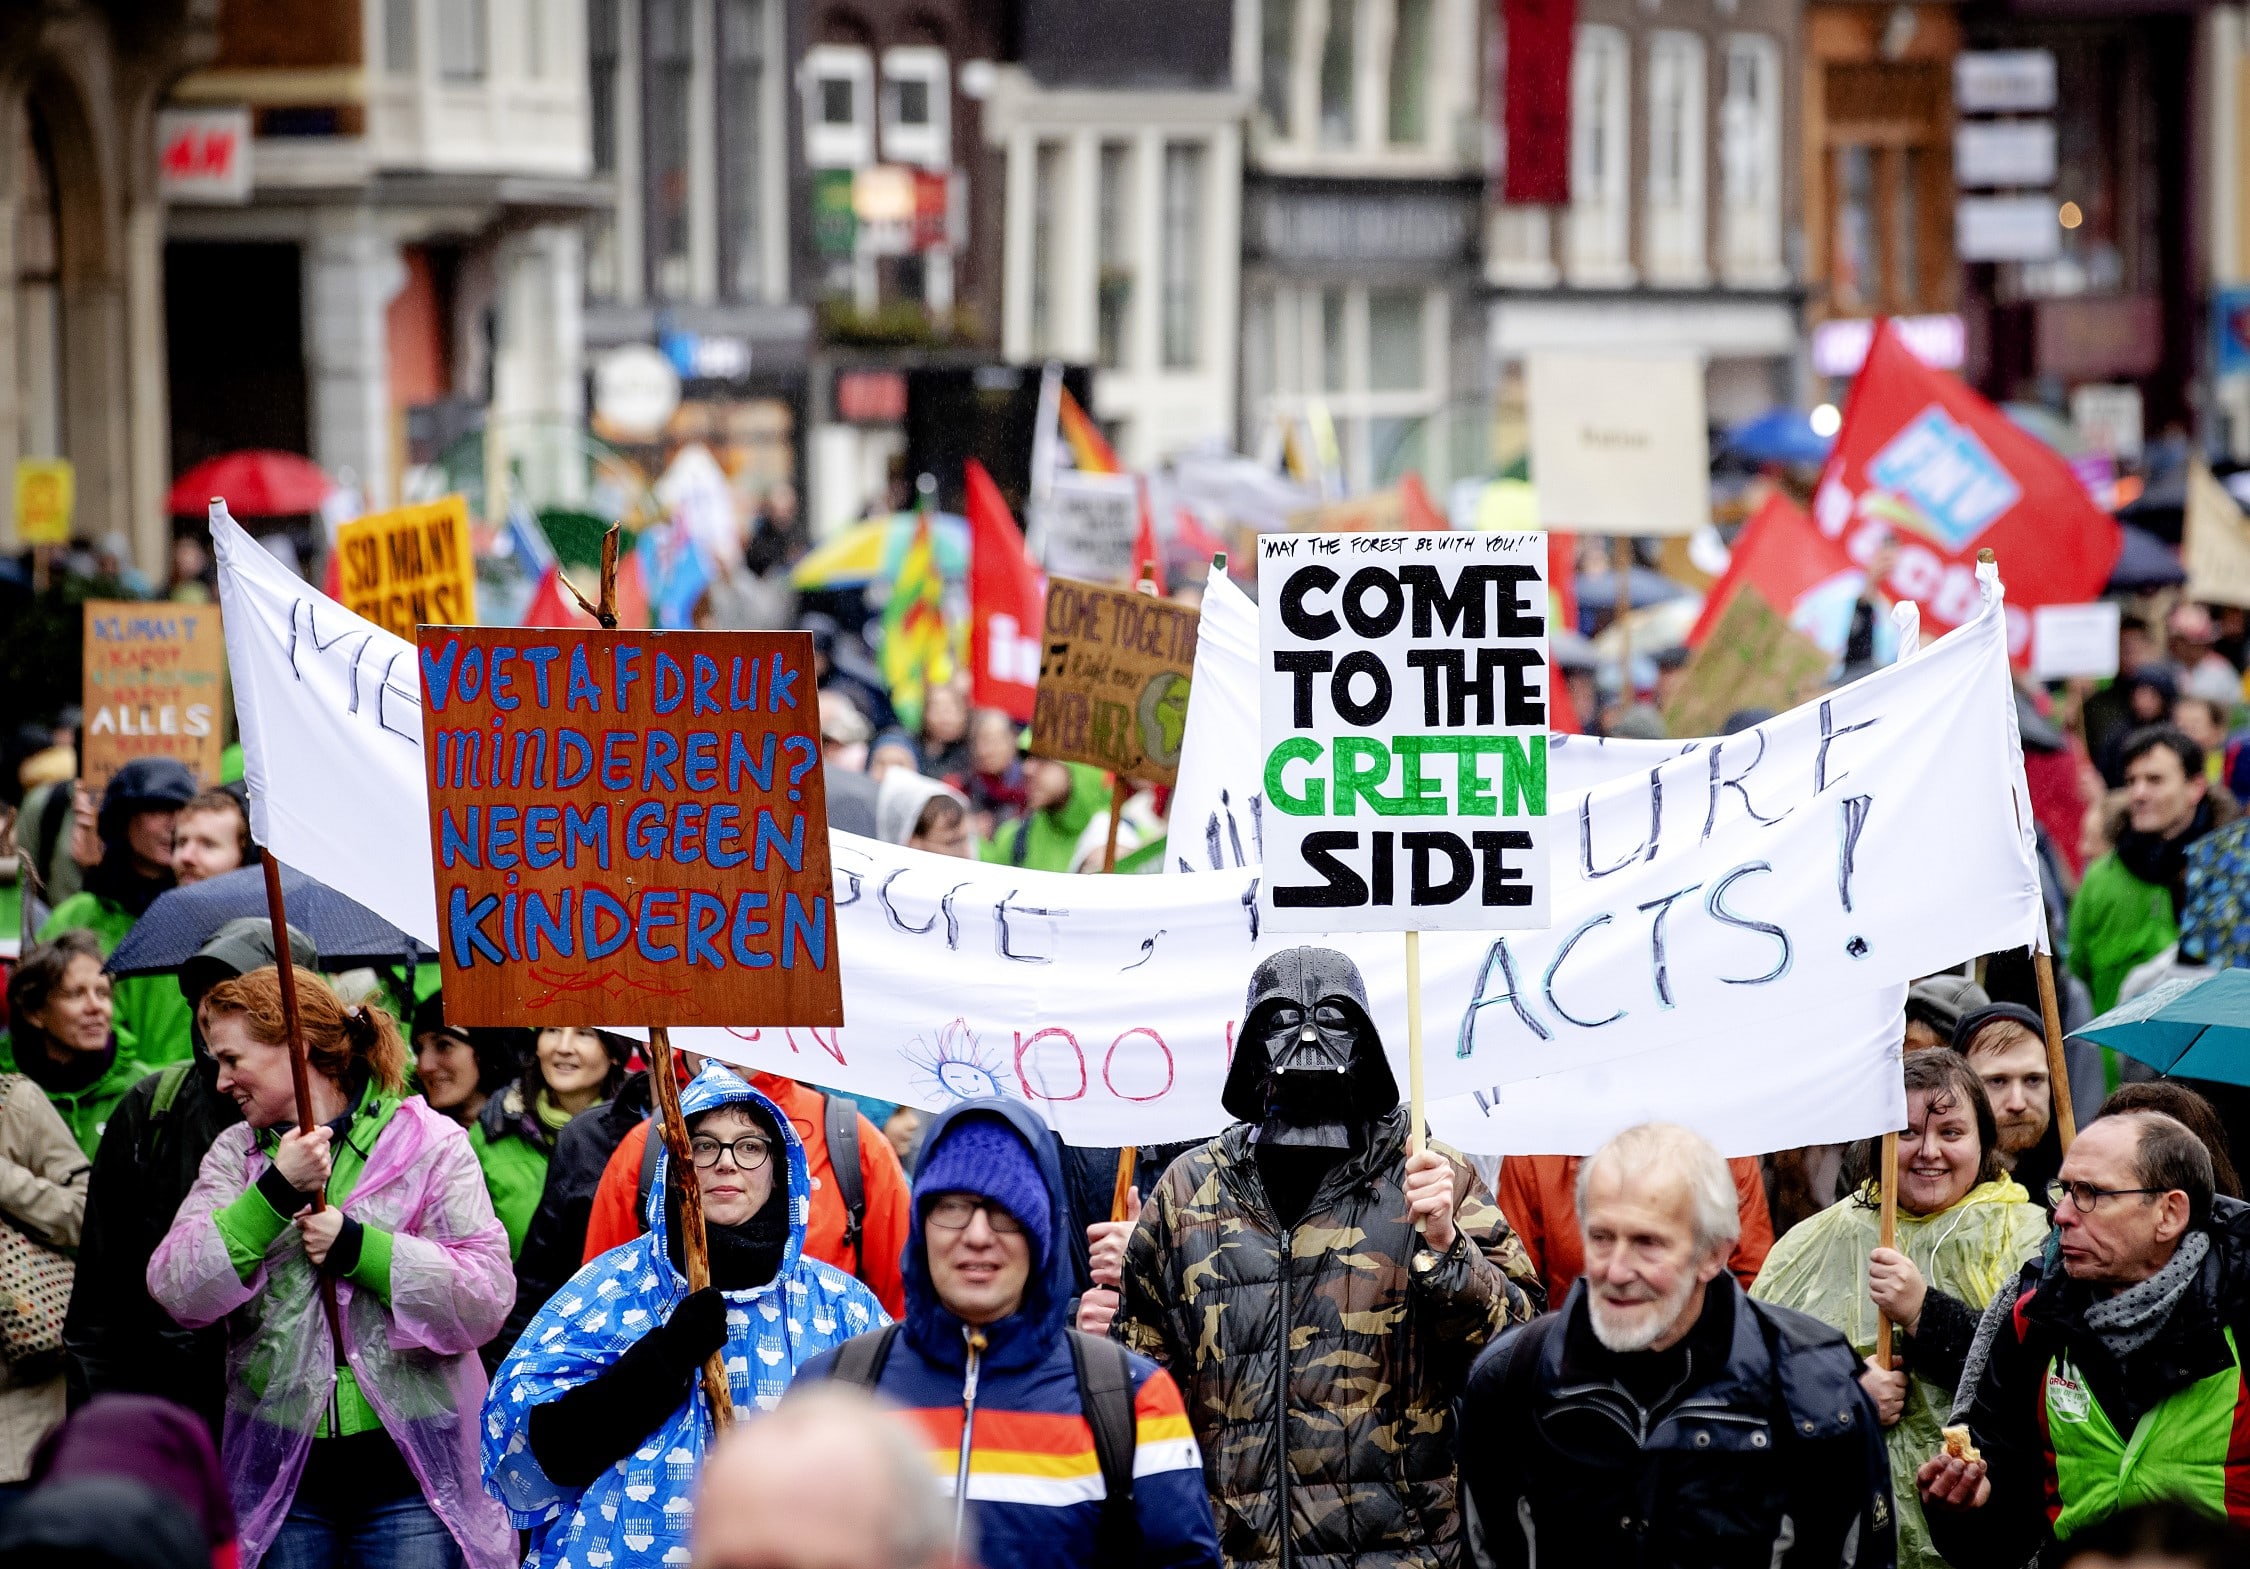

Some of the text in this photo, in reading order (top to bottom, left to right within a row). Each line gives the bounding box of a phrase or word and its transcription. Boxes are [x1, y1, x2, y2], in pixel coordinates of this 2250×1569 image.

[346, 534, 379, 594] SO
[1307, 536, 1342, 555] THE
[1350, 536, 1409, 554] FOREST
[1414, 537, 1433, 551] BE
[1438, 535, 1475, 550] WITH
[1045, 583, 1106, 643] COME
[1279, 565, 1545, 641] COME
[91, 703, 214, 737] ALLES
[1273, 648, 1546, 729] TO THE
[1263, 735, 1548, 817] GREEN
[440, 798, 807, 873] NEEM GEEN
[1272, 830, 1534, 908] SIDE
[1456, 794, 1875, 1060] ACTS!
